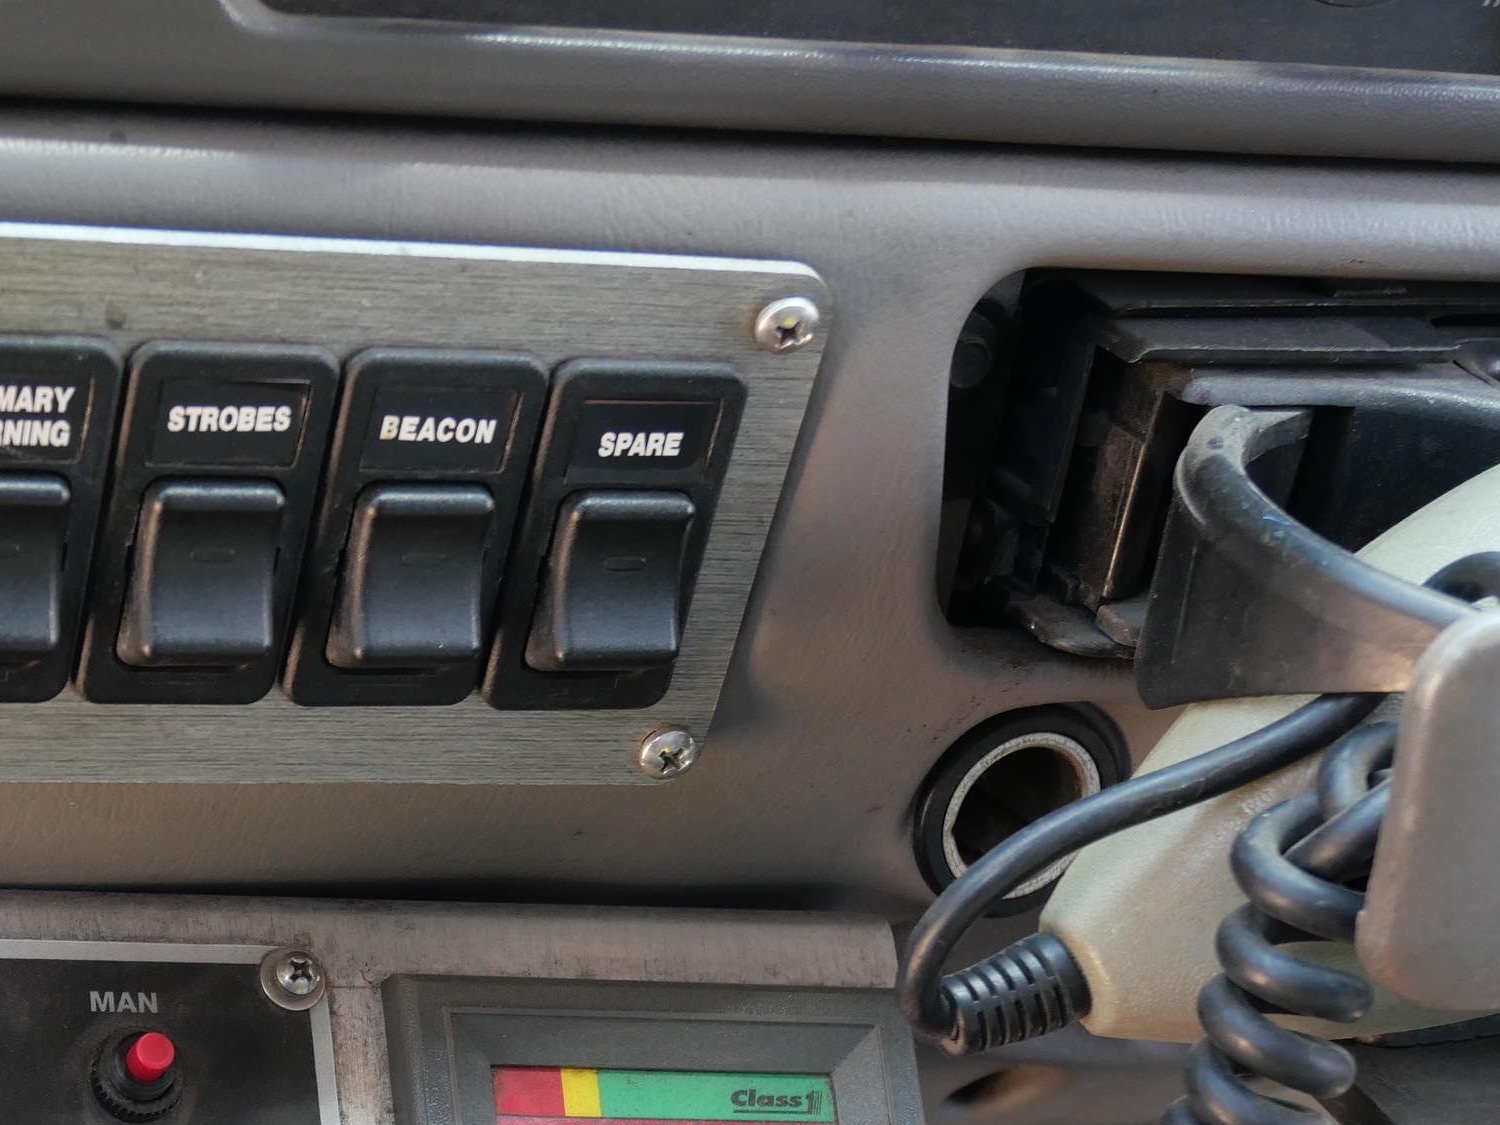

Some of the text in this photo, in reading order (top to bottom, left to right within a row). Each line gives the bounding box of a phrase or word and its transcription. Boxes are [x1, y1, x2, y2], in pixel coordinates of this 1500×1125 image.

[167, 405, 292, 433] STROBES
[379, 415, 496, 444] BEACON
[597, 431, 684, 458] SPARE
[89, 991, 158, 1013] MAN
